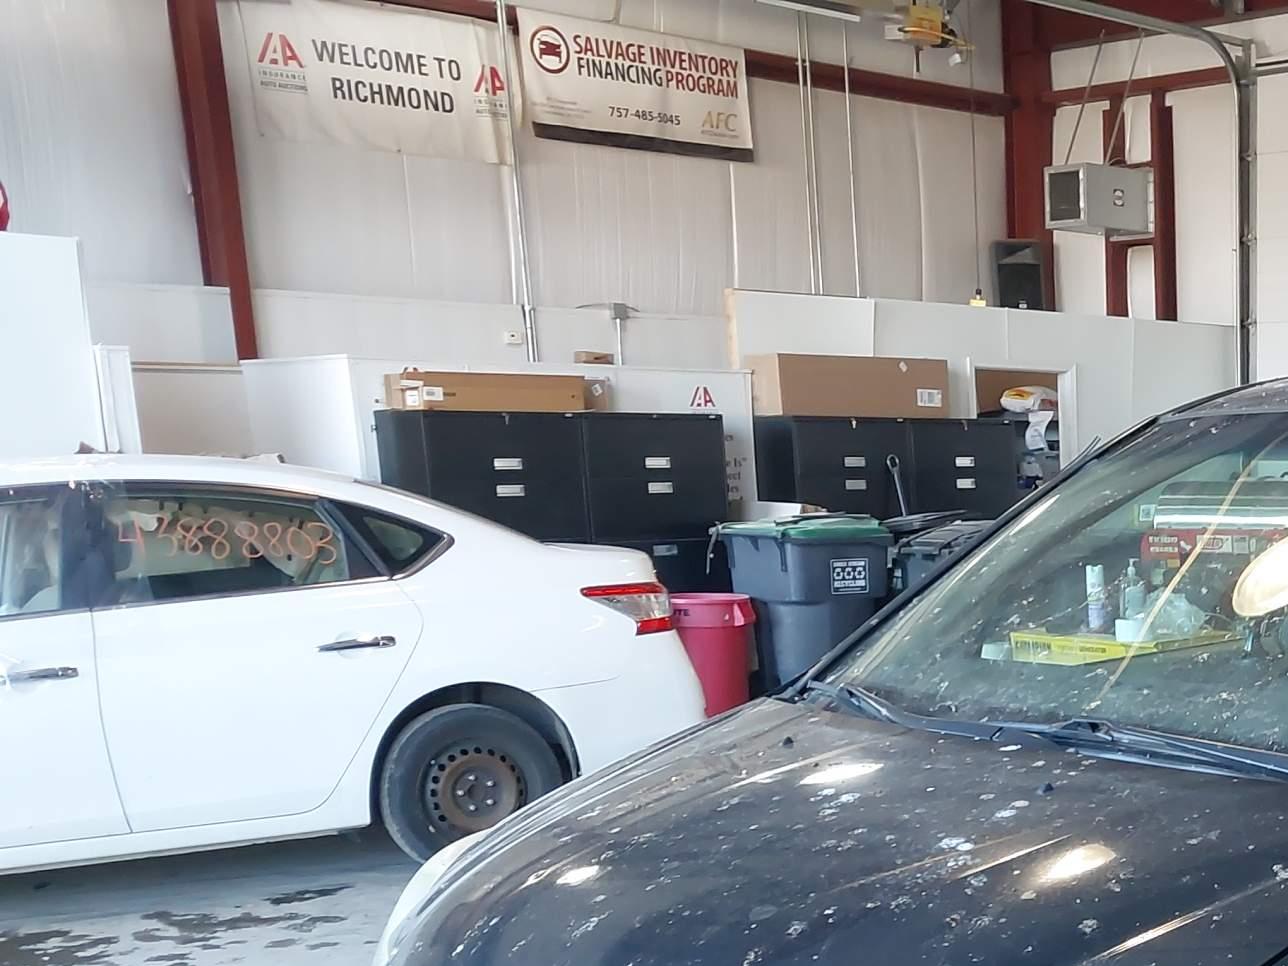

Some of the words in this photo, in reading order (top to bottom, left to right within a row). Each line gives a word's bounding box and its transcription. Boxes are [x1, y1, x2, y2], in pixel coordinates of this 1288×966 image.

[311, 38, 429, 77] WELCOME
[433, 56, 461, 81] TO
[573, 34, 647, 64] SALVAGE
[650, 46, 739, 79] INVENTORY
[331, 76, 454, 114] RICHMOND
[576, 56, 663, 88] FINANCING
[665, 71, 739, 99] PROGRAM
[608, 105, 681, 126] 757-485-5045
[702, 110, 738, 132] AFC
